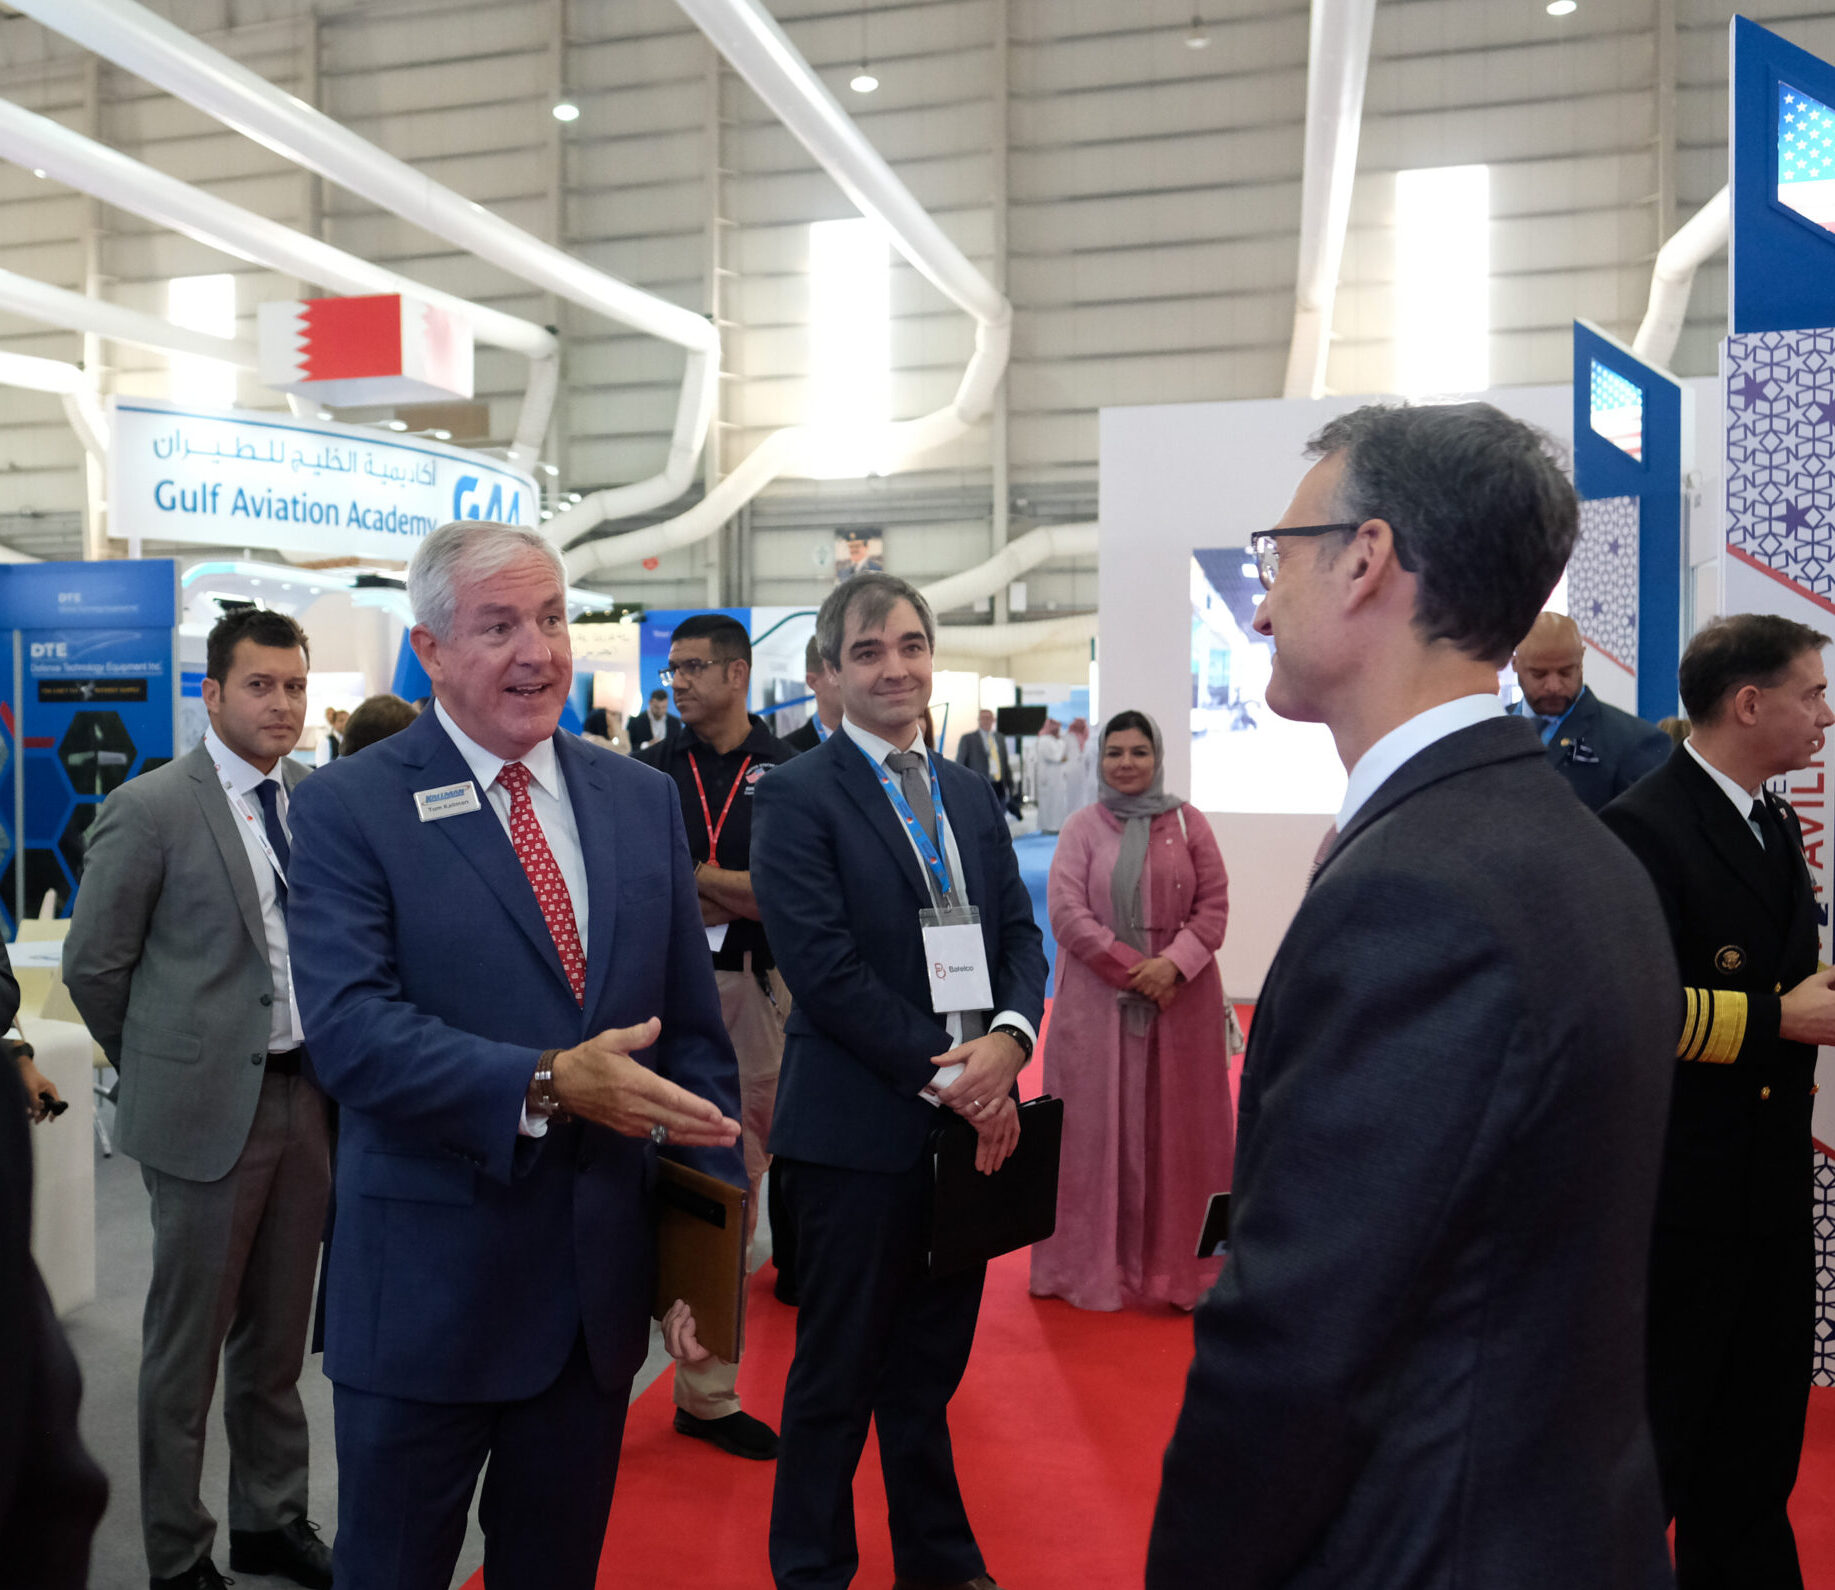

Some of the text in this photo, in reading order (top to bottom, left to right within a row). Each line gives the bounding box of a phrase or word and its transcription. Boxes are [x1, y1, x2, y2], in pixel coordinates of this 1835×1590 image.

[290, 446, 357, 476] الخليج
[154, 479, 223, 515] Gulf
[231, 487, 339, 526] Aviation
[30, 642, 67, 658] DTE
